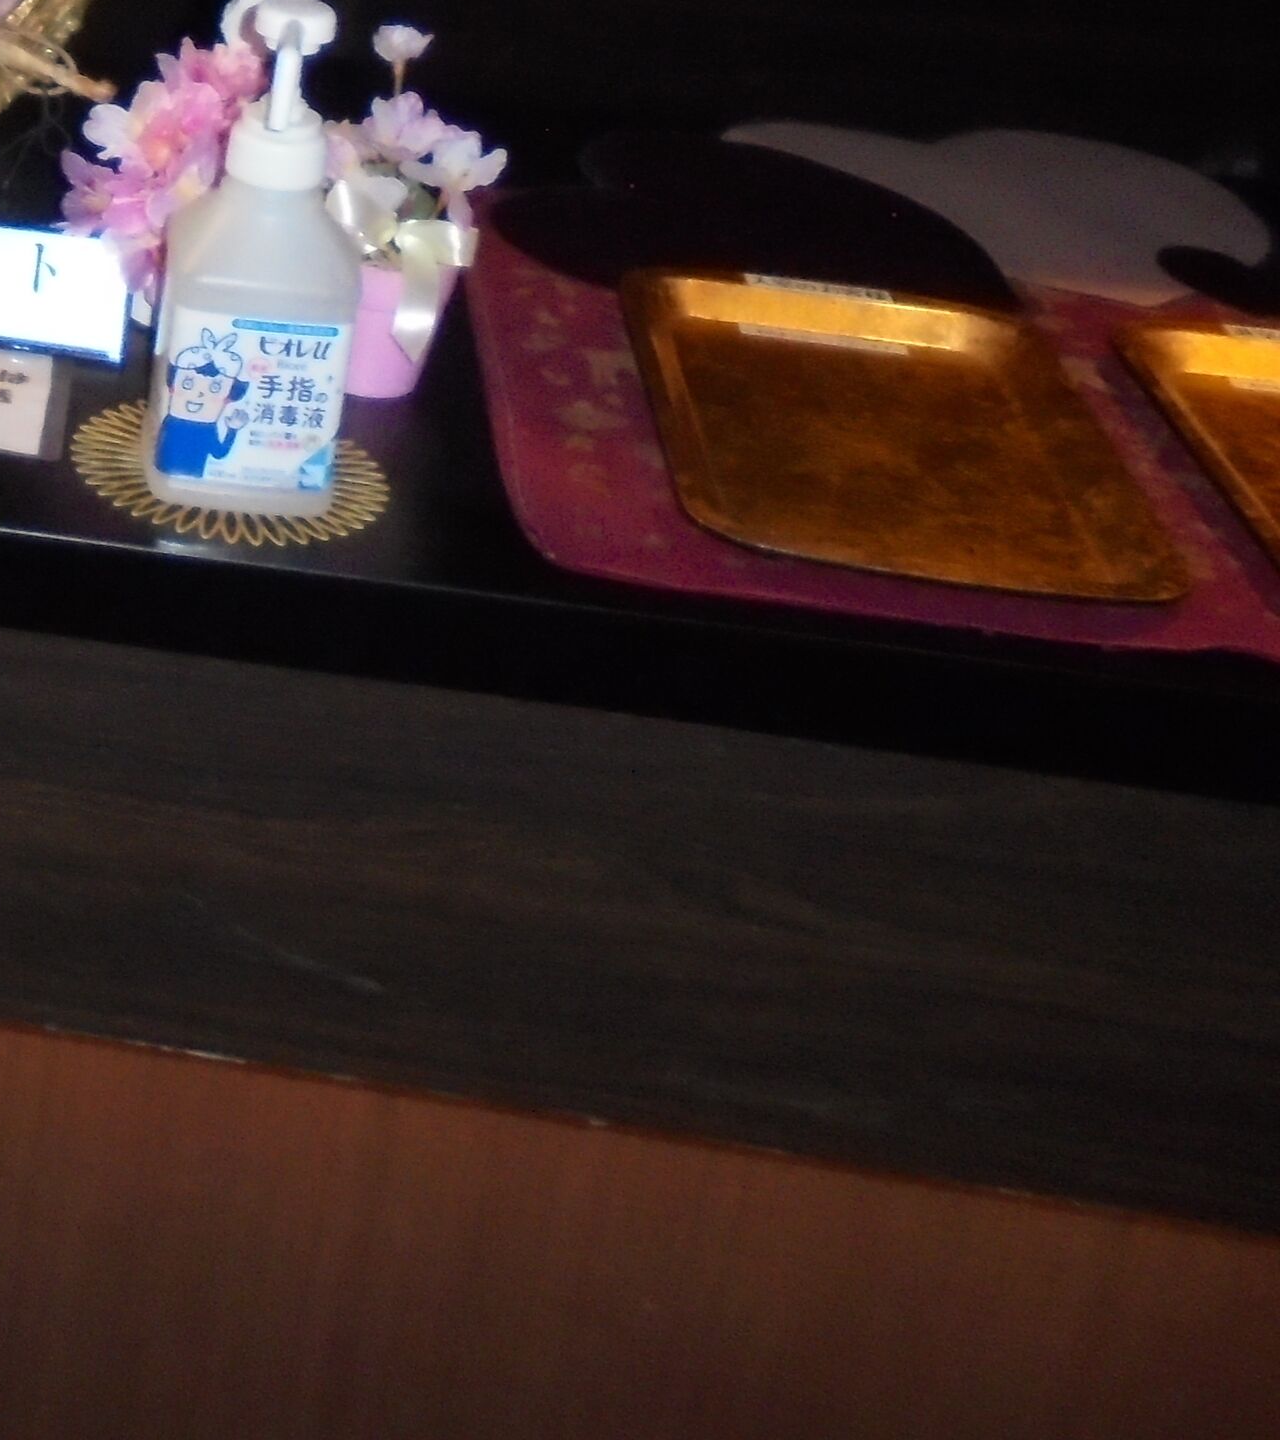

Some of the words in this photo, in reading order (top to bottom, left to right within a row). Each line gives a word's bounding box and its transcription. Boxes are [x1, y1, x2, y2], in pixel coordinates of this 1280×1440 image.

[257, 374, 329, 404] 手指の
[251, 402, 327, 429] 消毒液
